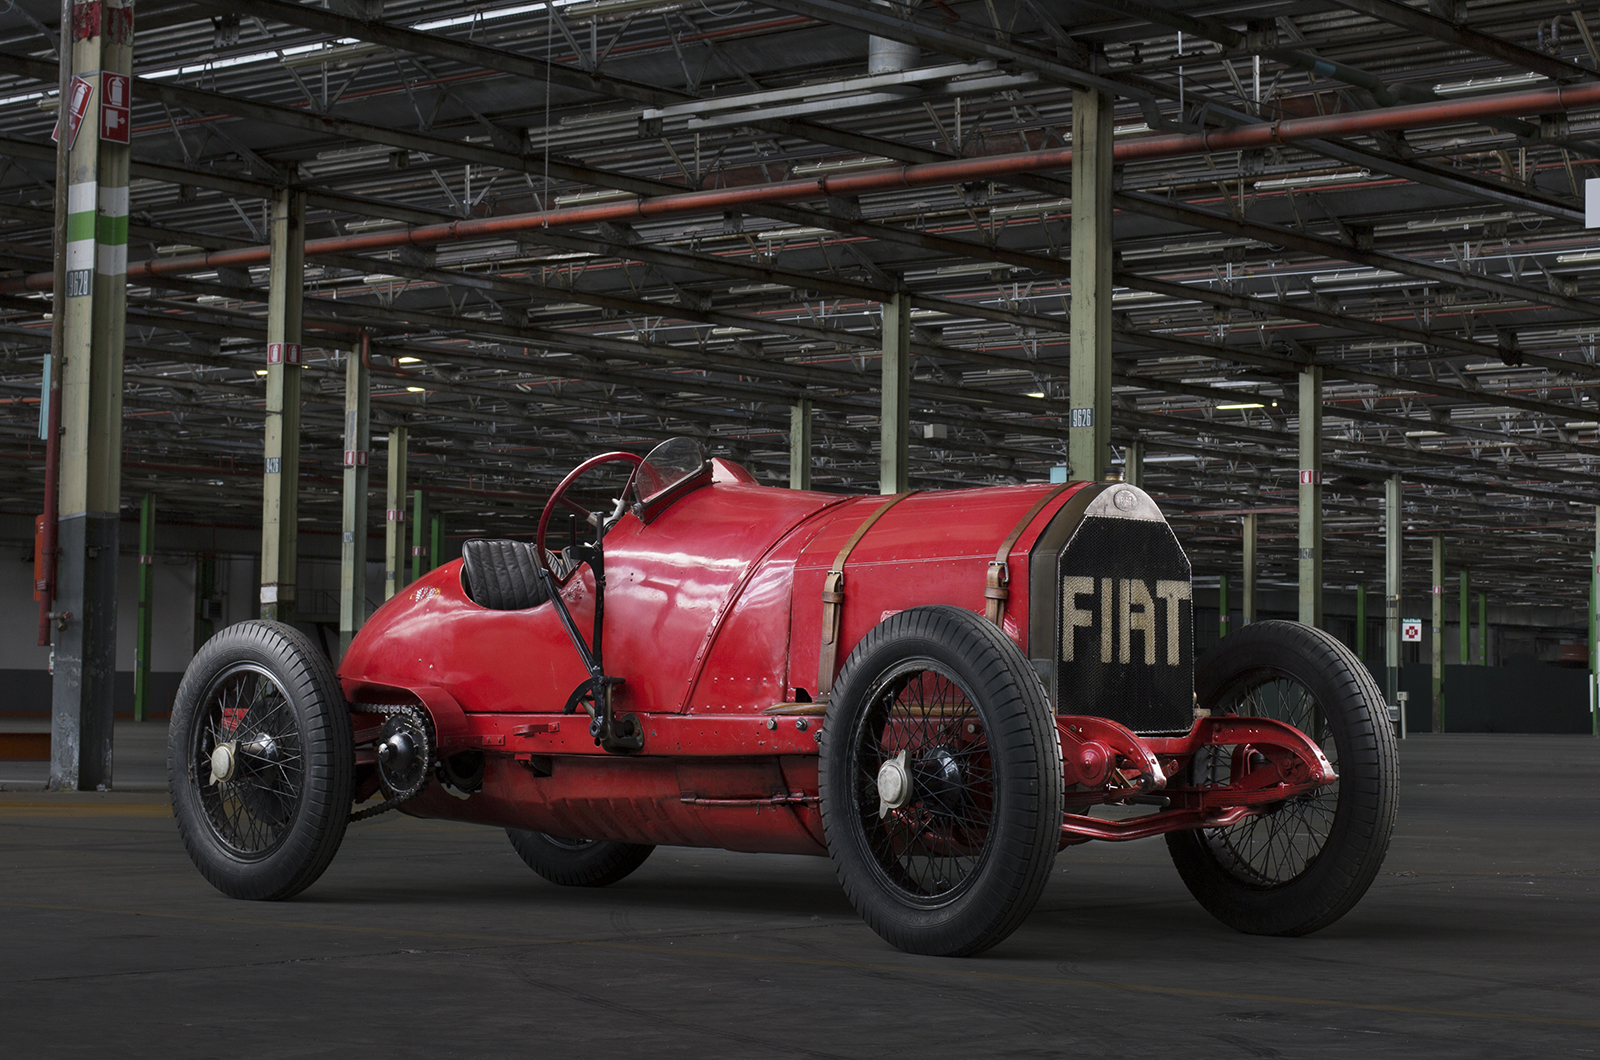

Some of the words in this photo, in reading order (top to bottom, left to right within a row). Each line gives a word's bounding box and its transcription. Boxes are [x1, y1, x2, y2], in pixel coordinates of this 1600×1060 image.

[69, 270, 88, 297] 9628
[1073, 408, 1091, 427] 9626
[266, 458, 279, 473] 9426
[1062, 575, 1191, 667] FIAT
